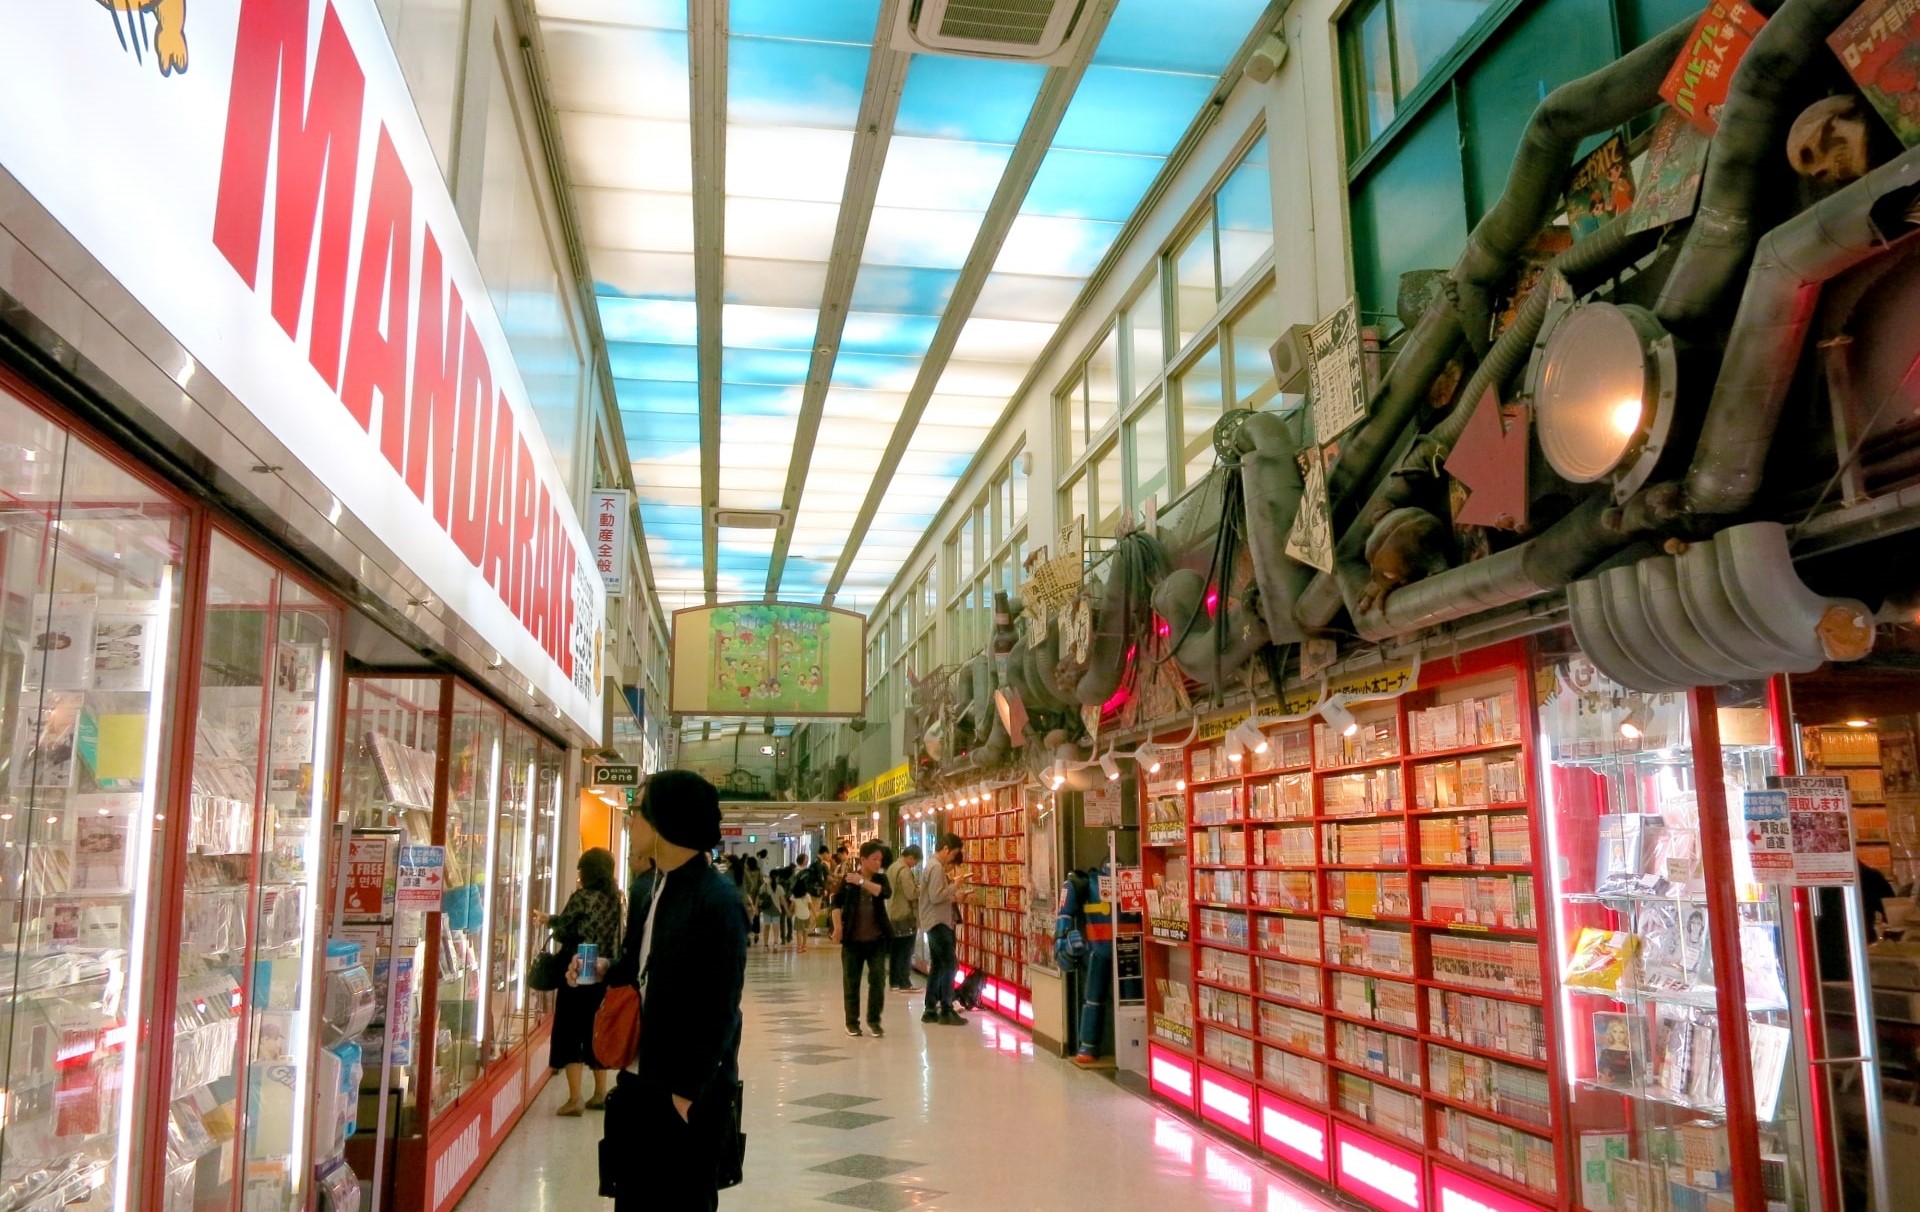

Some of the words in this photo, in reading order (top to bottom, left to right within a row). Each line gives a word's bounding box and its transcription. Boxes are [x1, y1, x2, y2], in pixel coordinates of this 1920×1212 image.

[1842, 0, 1920, 70] ロック冒険
[213, 0, 576, 681] MANDARAKE
[597, 498, 616, 573] 不動産全般
[357, 863, 383, 875] FREE
[359, 876, 382, 888] 면제
